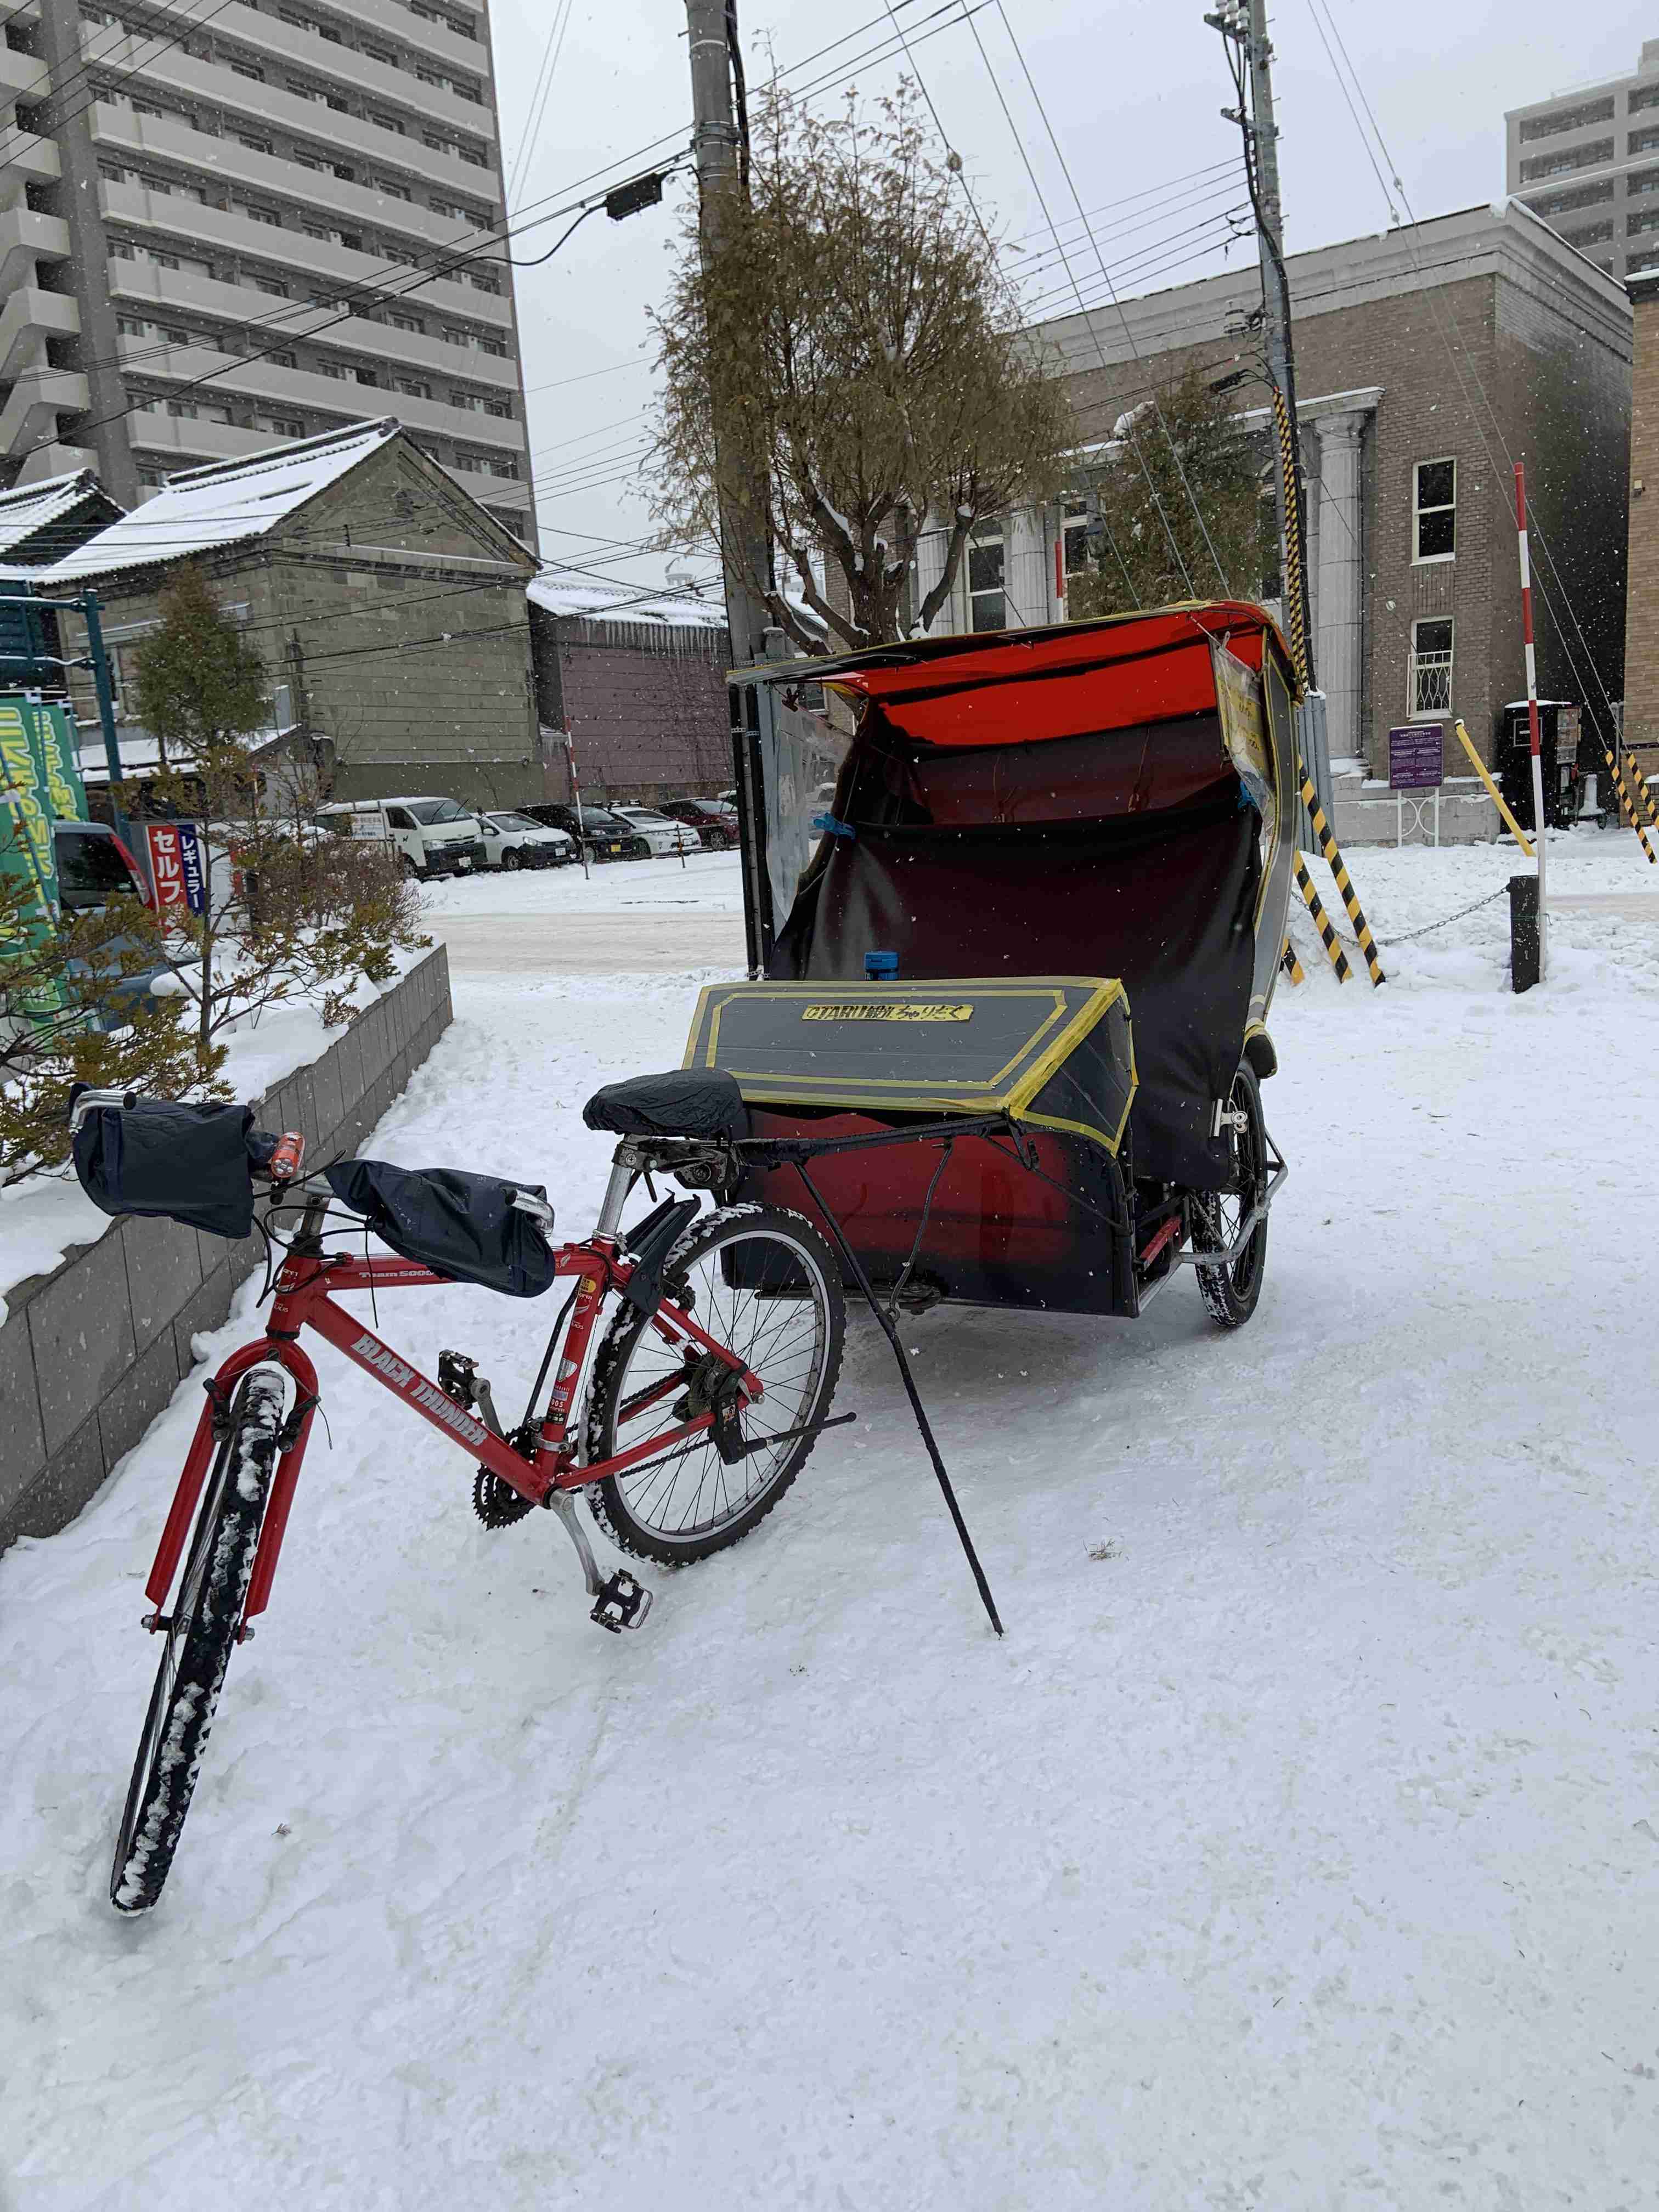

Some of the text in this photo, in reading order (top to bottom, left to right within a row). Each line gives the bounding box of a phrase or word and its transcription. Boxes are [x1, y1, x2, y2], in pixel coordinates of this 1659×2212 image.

[153, 830, 180, 904] セルフ
[181, 835, 201, 909] レギュラー
[351, 1333, 488, 1446] BLACK THUNDER
